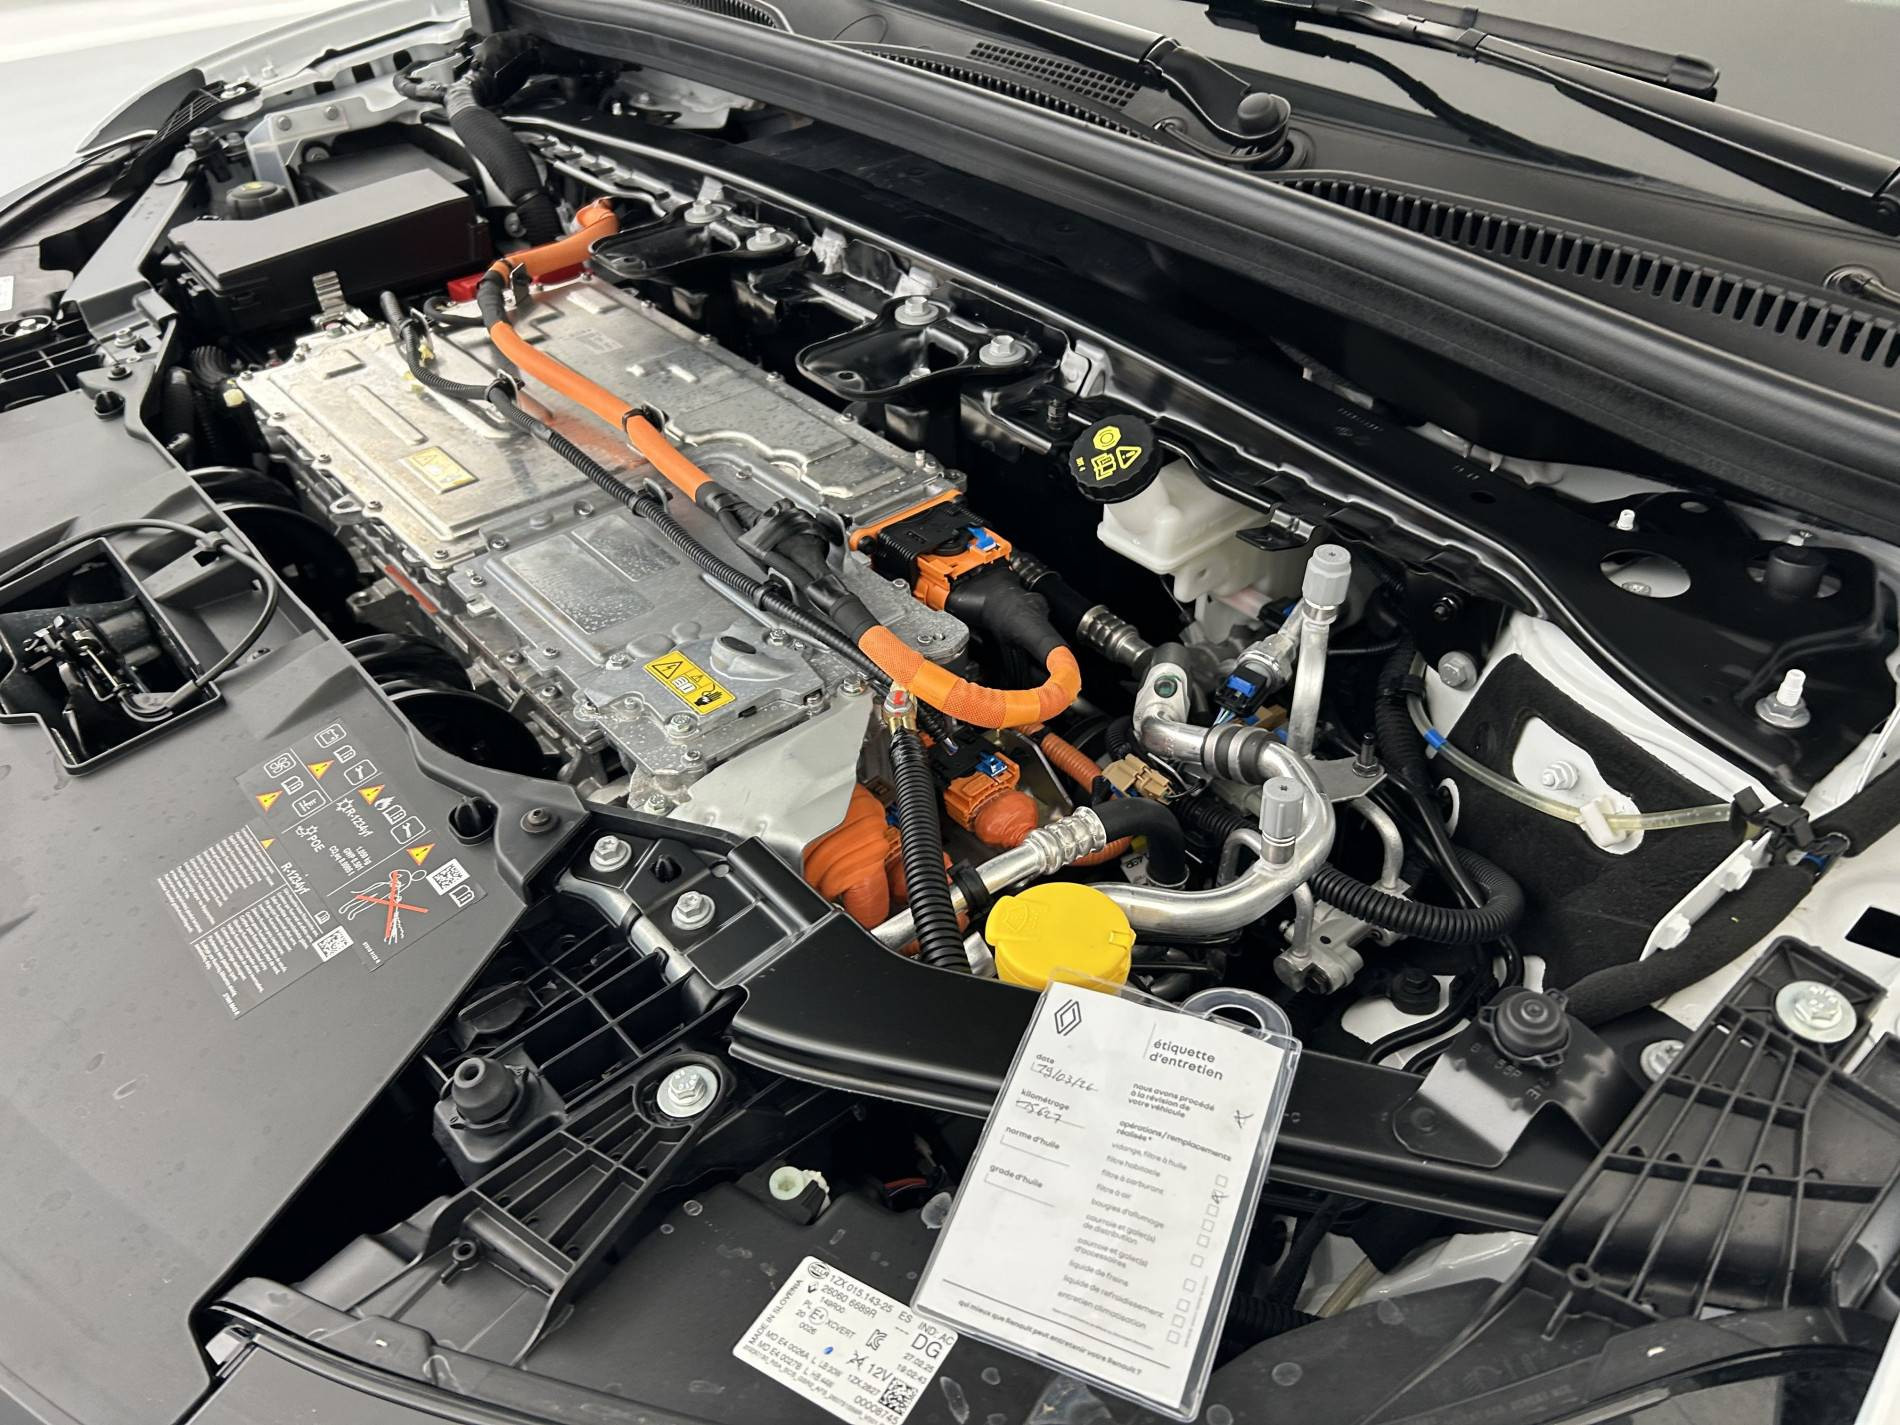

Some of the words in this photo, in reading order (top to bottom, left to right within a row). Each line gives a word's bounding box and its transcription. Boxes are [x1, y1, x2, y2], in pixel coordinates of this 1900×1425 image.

[306, 834, 325, 852] POE
[1036, 1054, 1054, 1064] date
[1154, 1039, 1215, 1062] étiquette
[1149, 1052, 1222, 1079] d'entretien
[1021, 1089, 1069, 1110] kilométrage
[1128, 1098, 1149, 1107] votre
[1150, 1104, 1185, 1118] véhicule
[1133, 1083, 1152, 1092] nous
[1153, 1089, 1178, 1099] avons
[1178, 1095, 1214, 1111] procédé
[1145, 1094, 1178, 1107] révision
[1179, 1103, 1190, 1111] de
[1005, 1126, 1032, 1139] norme
[1032, 1136, 1059, 1149] d'huile
[1119, 1121, 1161, 1136] opérations
[989, 1165, 1014, 1177] grade
[1015, 1174, 1042, 1188] d'huile
[748, 1323, 768, 1344] MADE
[773, 1280, 803, 1313] SLOVENIA
[821, 1284, 848, 1302] 26060
[848, 1299, 877, 1318] 6689R
[830, 1275, 848, 1288] 1ZX
[846, 1284, 893, 1312] 015.143-25
[898, 1310, 912, 1323] ES
[938, 1333, 954, 1345] AC
[911, 1333, 942, 1358] DG
[867, 1363, 893, 1381] 12V
